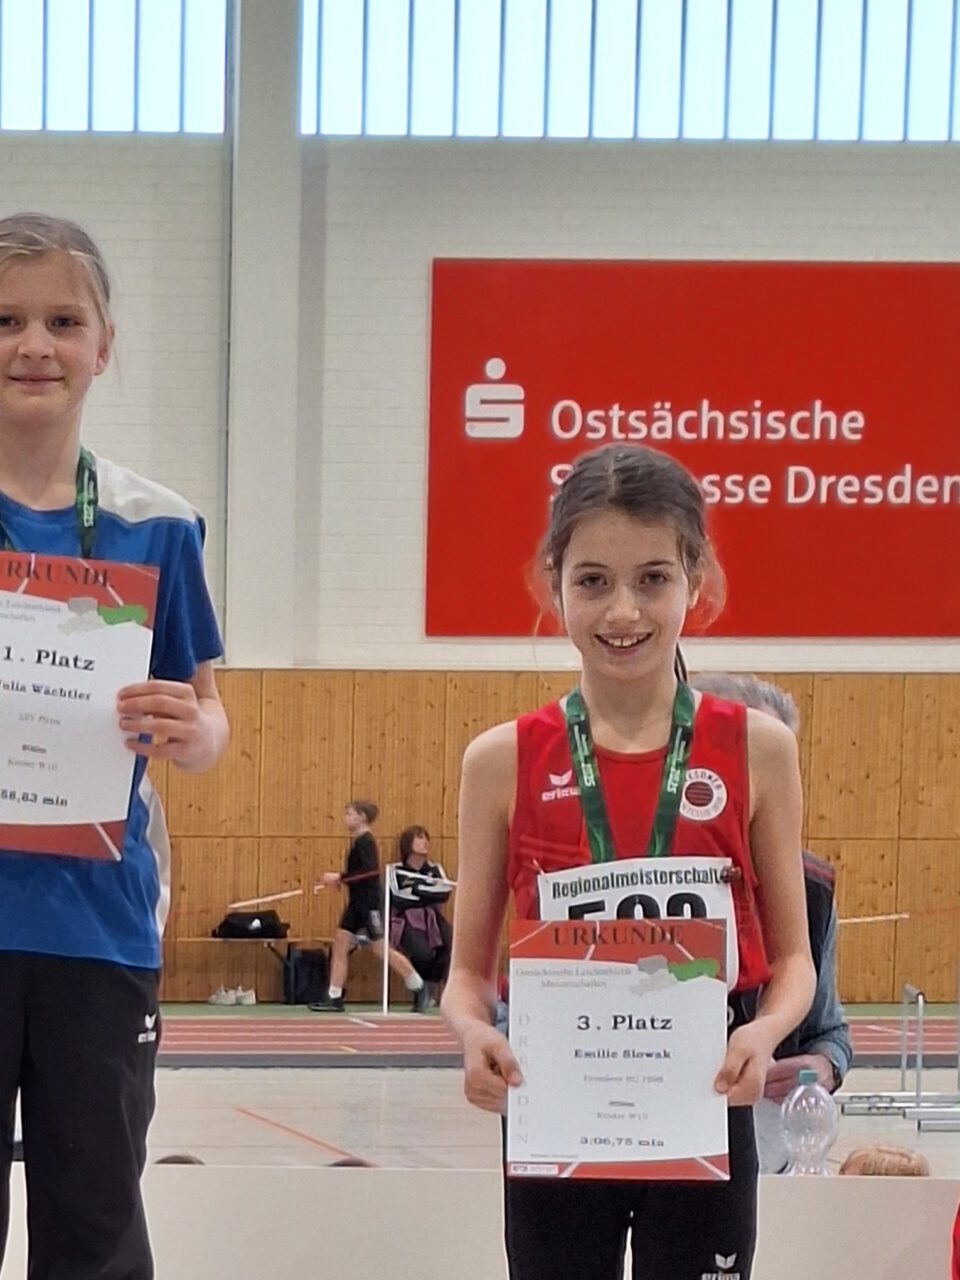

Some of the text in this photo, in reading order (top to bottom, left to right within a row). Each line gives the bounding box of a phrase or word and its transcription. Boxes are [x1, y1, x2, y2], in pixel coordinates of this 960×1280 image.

[550, 399, 865, 440] Ostsächsische
[786, 463, 960, 504] Dresden
[2, 646, 96, 672] 1. Platz
[42, 795, 69, 807] min
[552, 866, 732, 899] Regionalmeisterschaft
[552, 925, 684, 945] URKUNDE
[576, 1014, 673, 1031] 3. Platz
